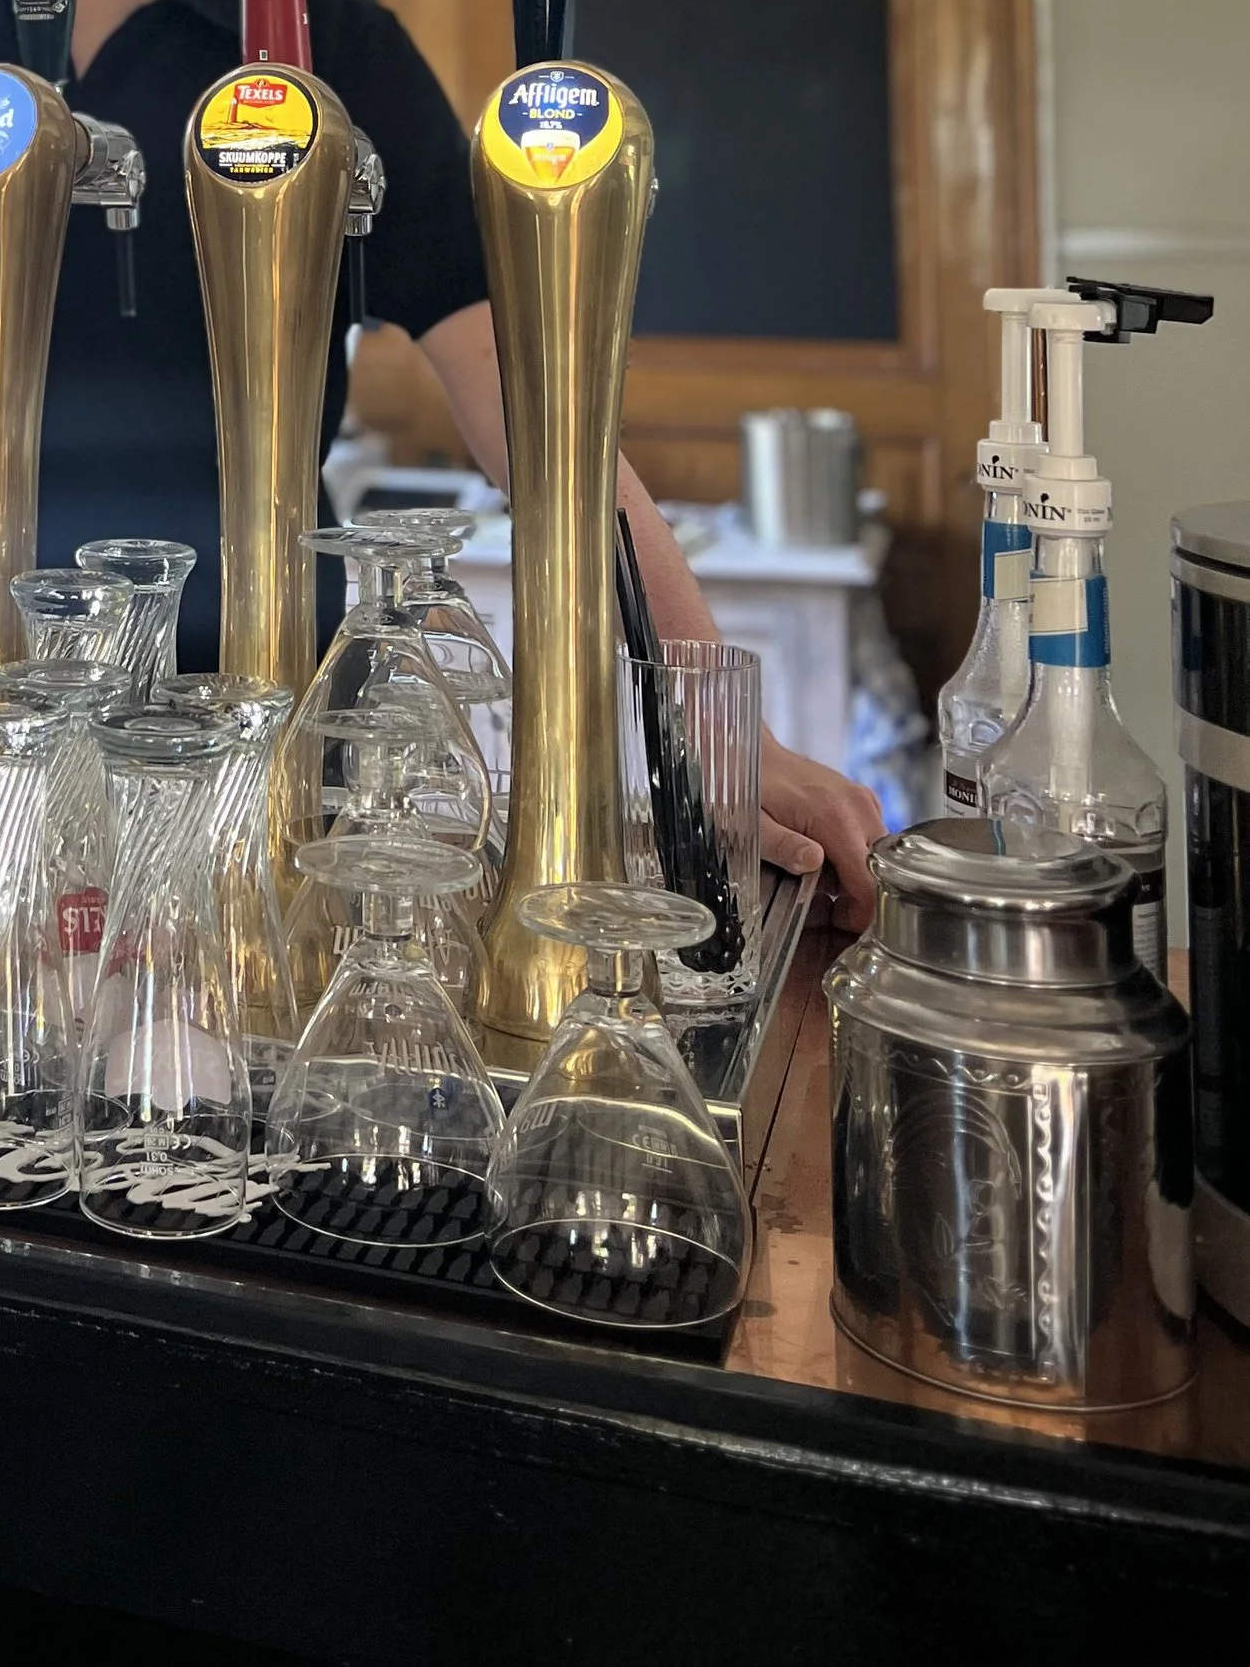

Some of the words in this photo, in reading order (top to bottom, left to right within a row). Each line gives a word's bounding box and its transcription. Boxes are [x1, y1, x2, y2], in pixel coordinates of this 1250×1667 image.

[237, 85, 284, 101] TEXELS
[508, 82, 600, 109] Affligem
[528, 108, 576, 120] BLOND
[218, 151, 287, 164] SKUUMKOPPE
[978, 455, 1016, 480] NIN
[1022, 492, 1067, 521] NIN
